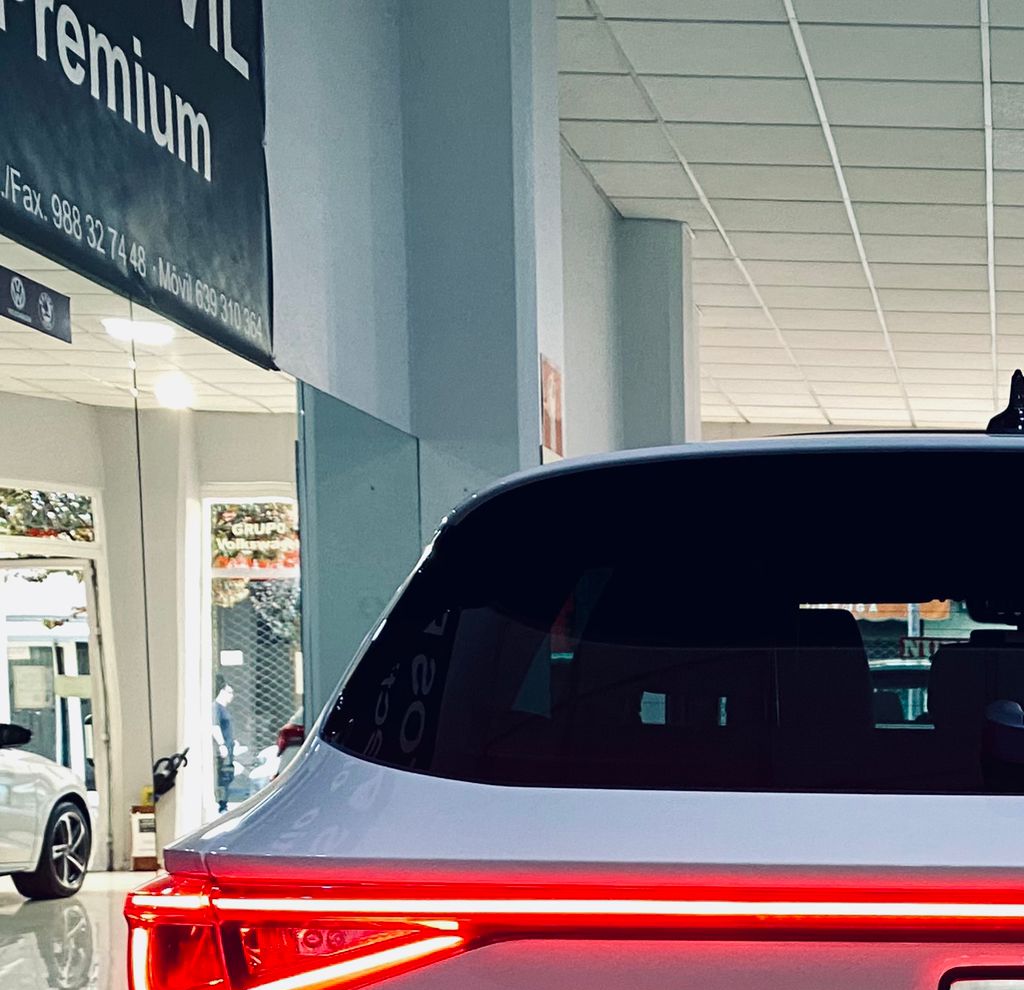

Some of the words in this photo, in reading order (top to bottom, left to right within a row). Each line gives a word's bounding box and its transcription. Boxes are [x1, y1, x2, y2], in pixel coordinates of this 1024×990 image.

[51, 194, 82, 240] 988
[86, 214, 106, 255] 32
[107, 226, 127, 266] 74
[129, 242, 146, 278] 48
[195, 279, 217, 318] 639
[220, 293, 240, 329] 310
[231, 522, 287, 537] GRUPO
